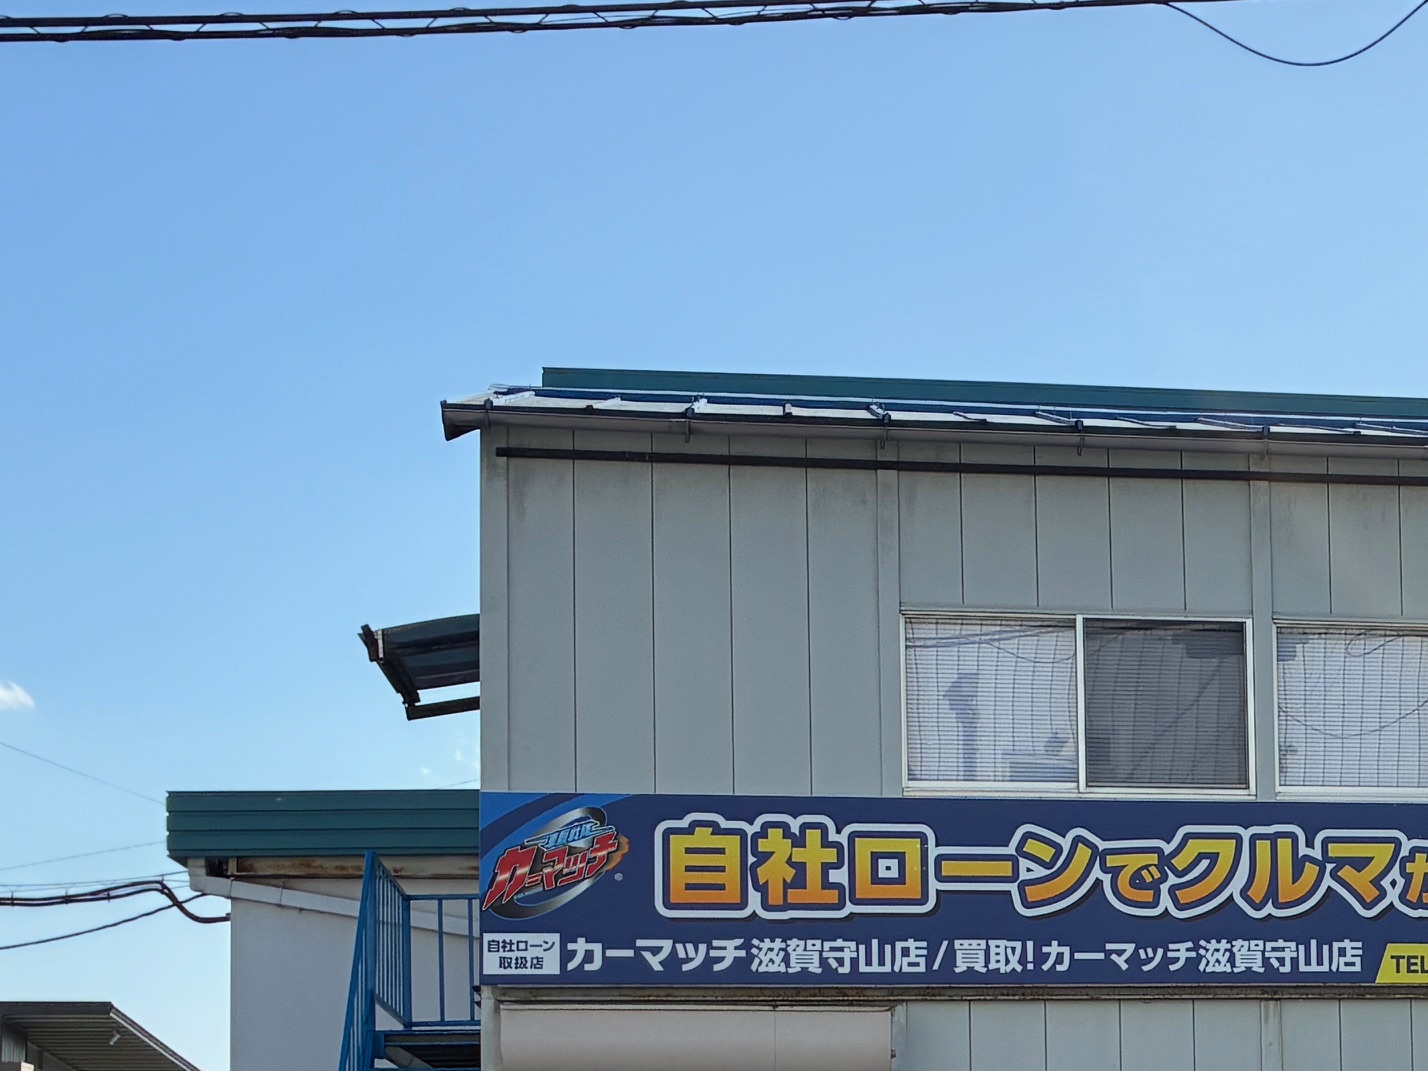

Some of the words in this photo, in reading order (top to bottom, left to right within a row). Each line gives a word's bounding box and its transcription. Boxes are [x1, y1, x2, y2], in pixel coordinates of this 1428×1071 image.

[482, 831, 618, 911] カーマッチ
[487, 939, 556, 953] 自社ローン
[498, 956, 544, 970] 取扱店
